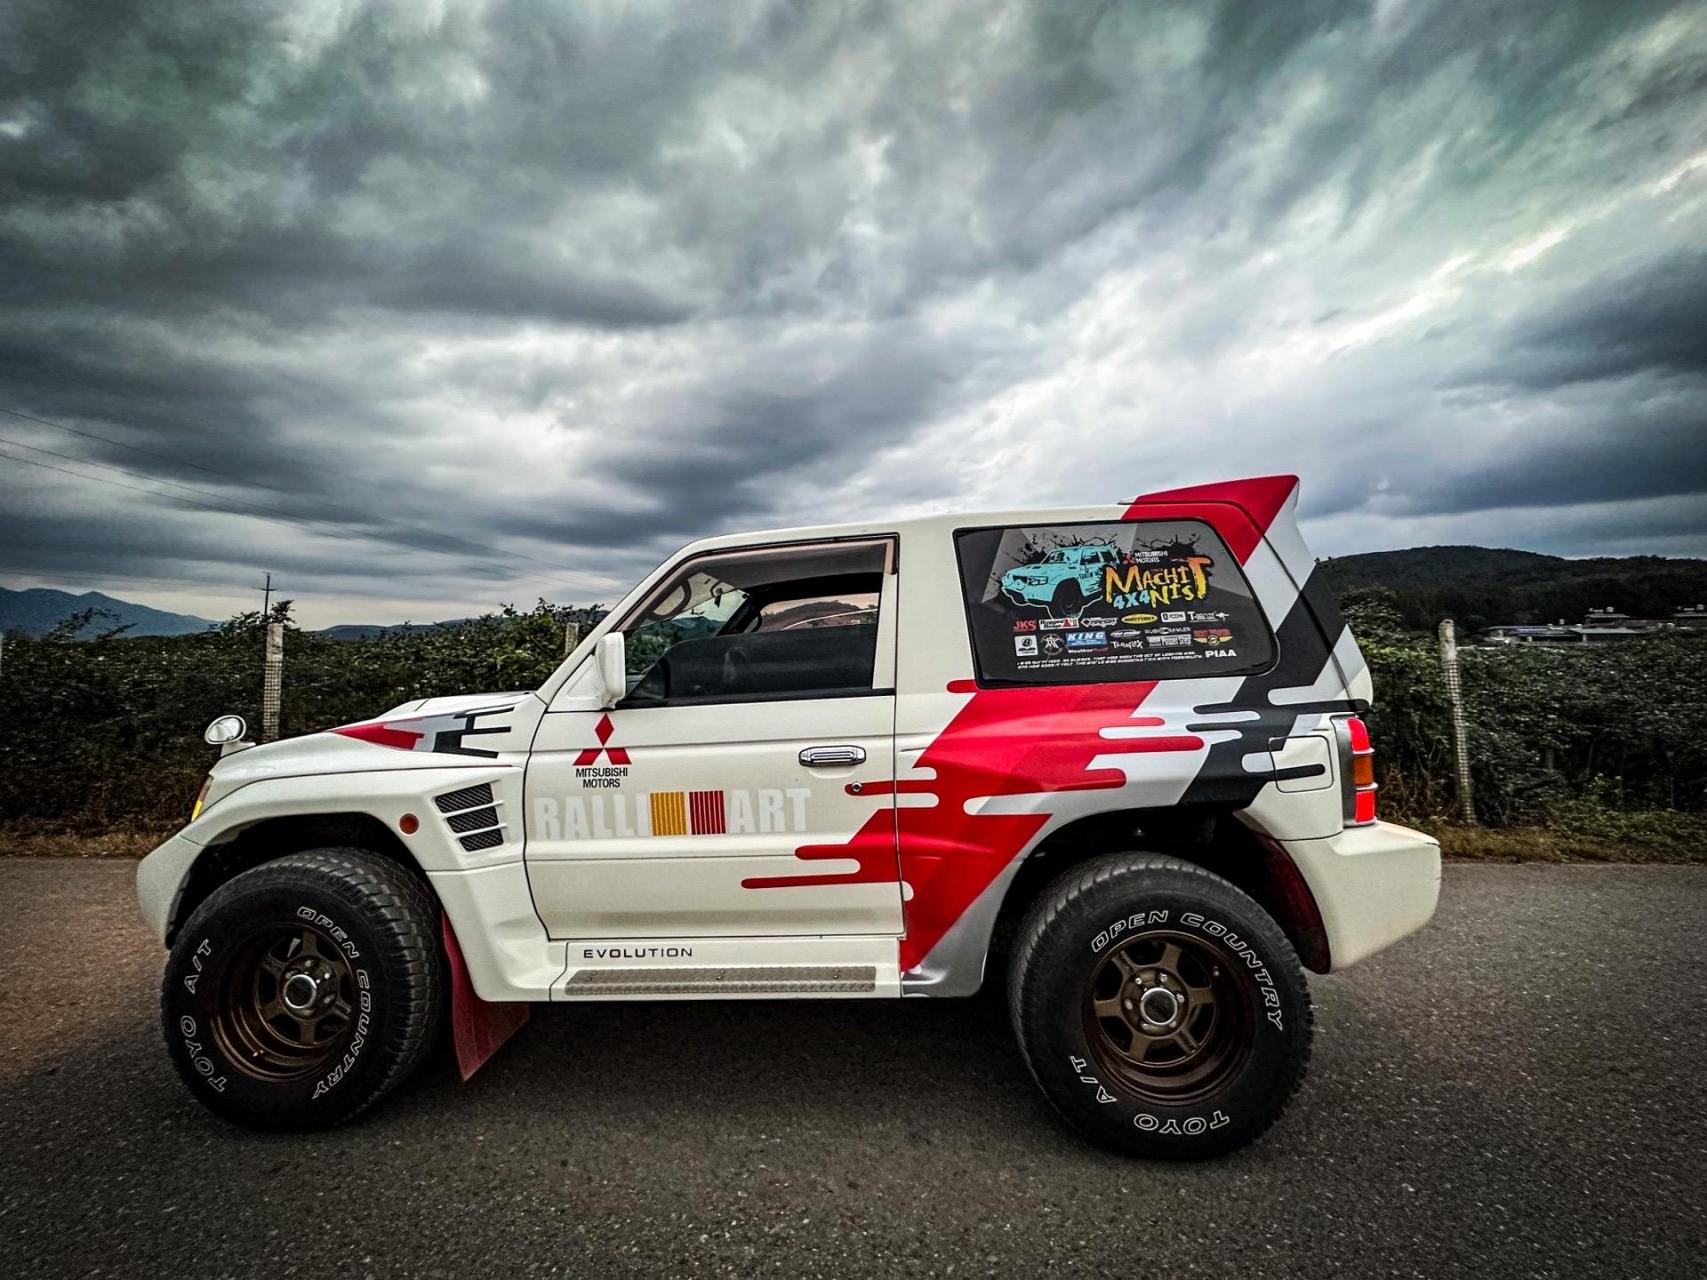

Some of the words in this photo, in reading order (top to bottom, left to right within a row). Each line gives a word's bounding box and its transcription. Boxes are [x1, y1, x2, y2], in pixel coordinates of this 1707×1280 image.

[1013, 619, 1037, 631] JKS
[1068, 631, 1105, 640] KING
[1205, 649, 1237, 658] PIAA
[575, 767, 628, 778] MITSUBISHI
[582, 778, 621, 788] MOTORS
[533, 792, 650, 841] RALLI
[730, 788, 812, 835] ART
[297, 906, 360, 959] OPEN
[184, 939, 212, 995] A/T
[583, 947, 693, 959] EVOLUTION
[1091, 910, 1169, 953] OPEN
[1180, 912, 1284, 1032] COUNTRY
[312, 969, 371, 1100] COUNTRY
[180, 1015, 227, 1093] TOYO
[1070, 1055, 1118, 1104] A/T
[1133, 1110, 1230, 1135] TOYO
